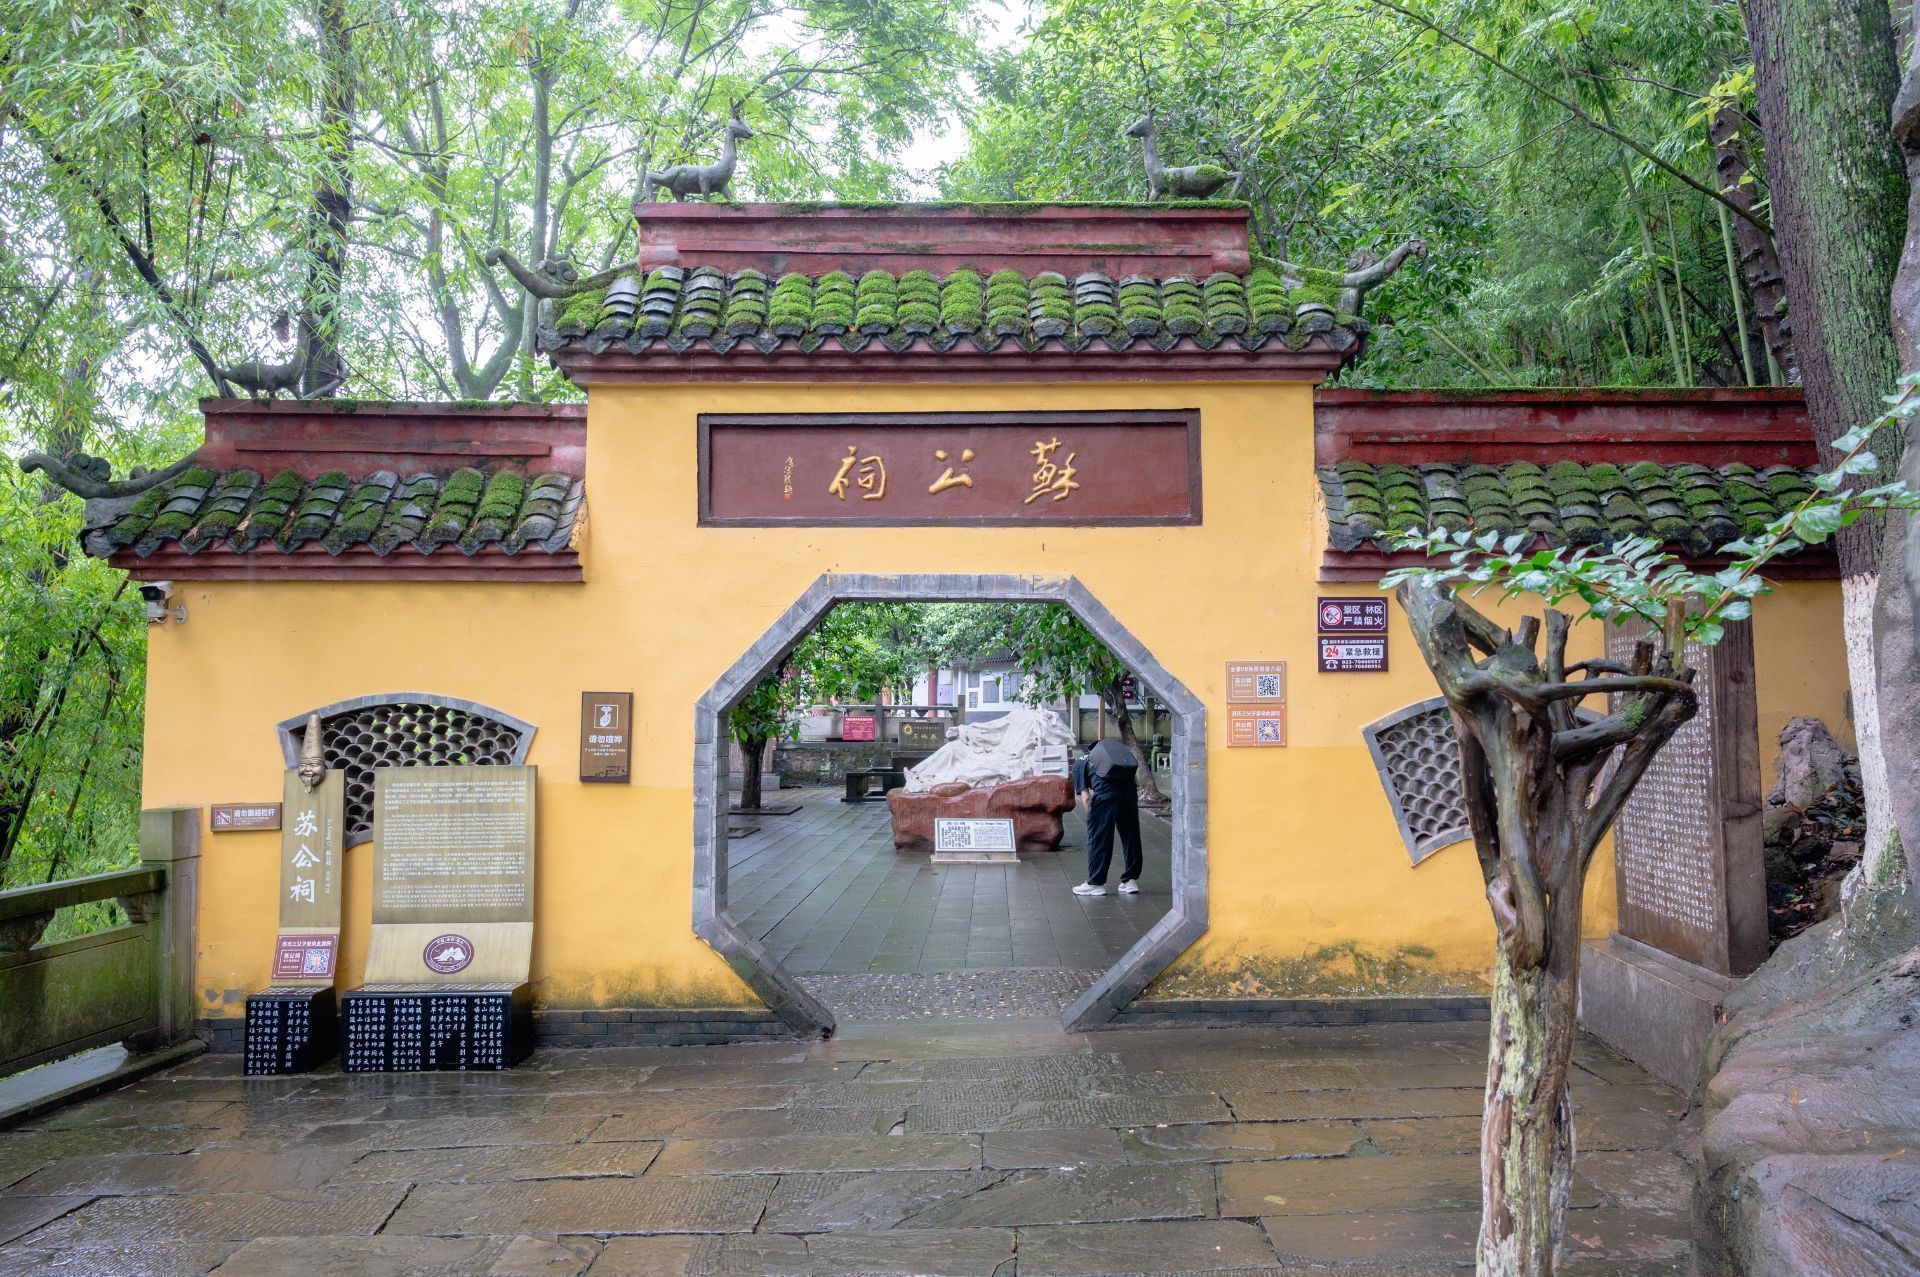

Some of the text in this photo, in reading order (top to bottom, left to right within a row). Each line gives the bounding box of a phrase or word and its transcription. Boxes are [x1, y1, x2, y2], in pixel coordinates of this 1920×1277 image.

[1344, 606, 1383, 614] 景区 林区
[1343, 616, 1383, 626] 严禁烟火
[1325, 646, 1381, 657] 24 紧急救援
[589, 735, 623, 744] 请勿喧哗
[289, 809, 320, 904] 苏公祠
